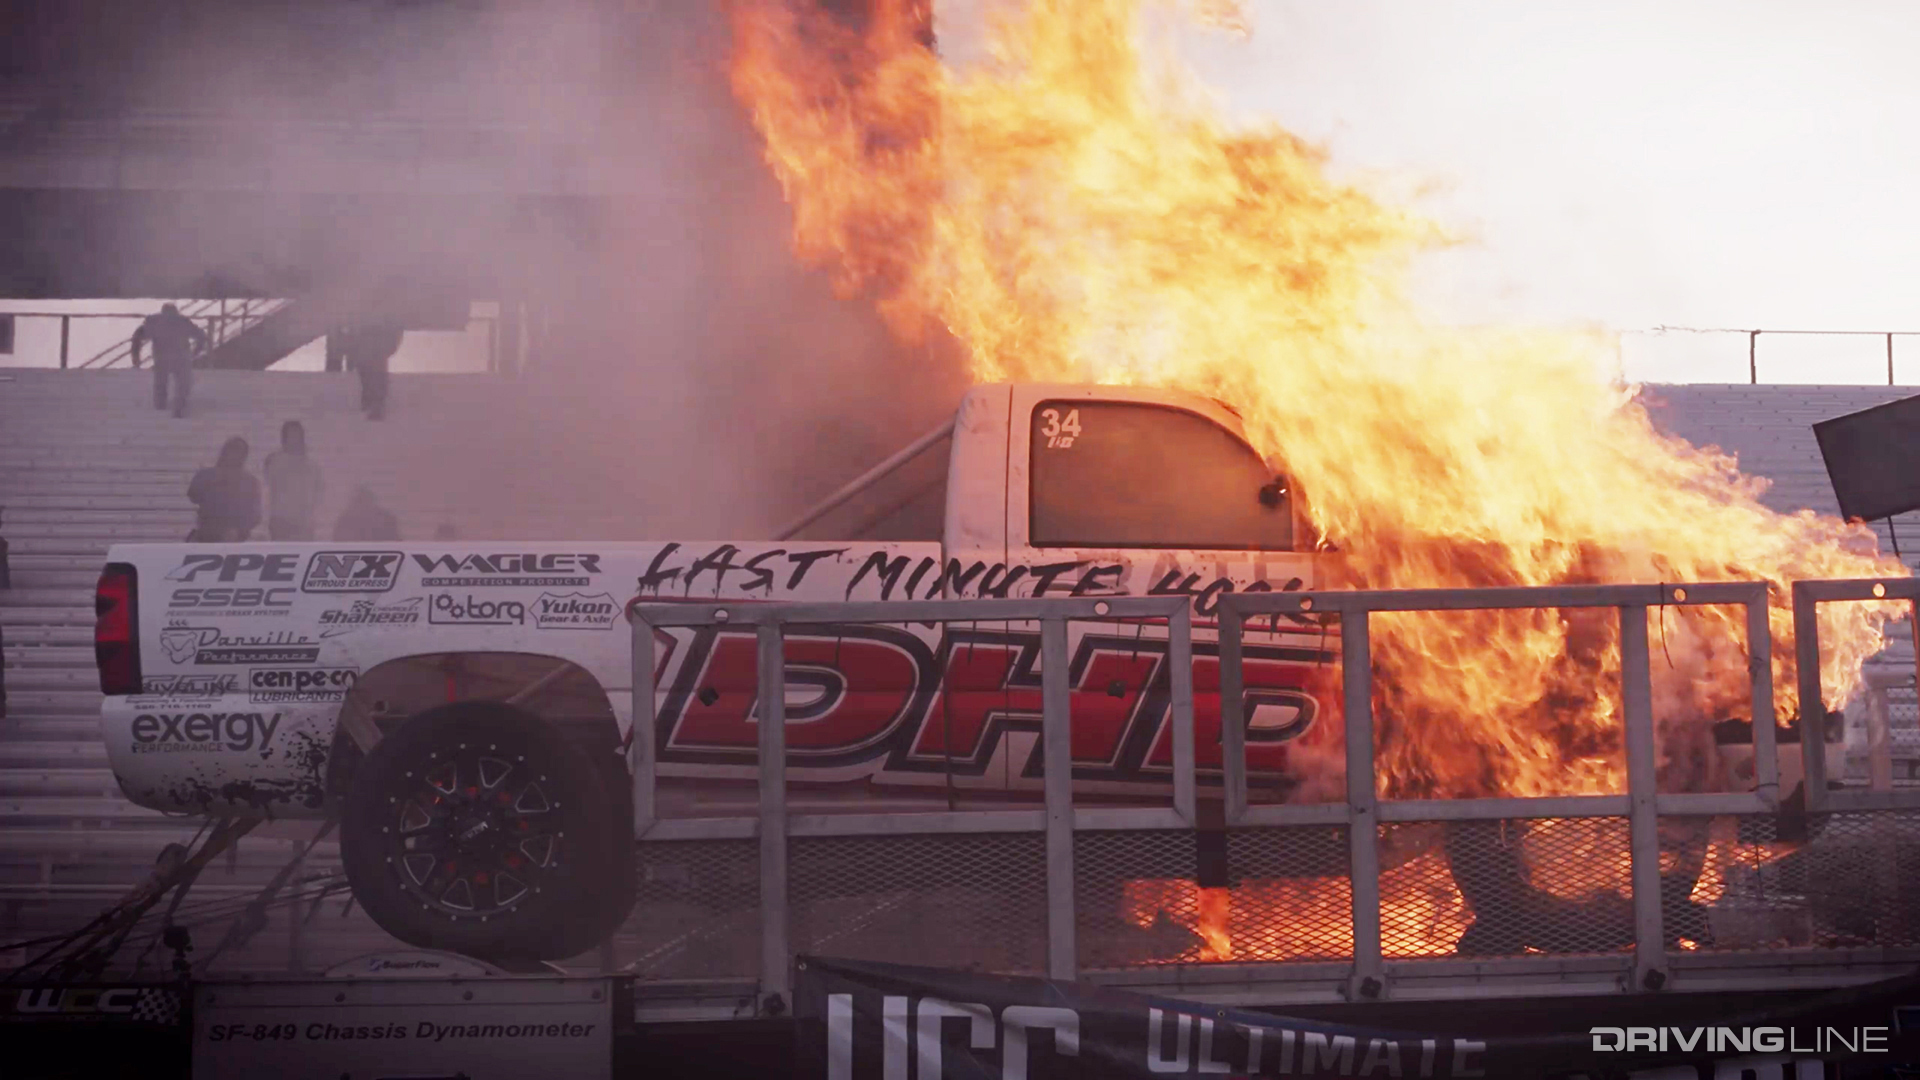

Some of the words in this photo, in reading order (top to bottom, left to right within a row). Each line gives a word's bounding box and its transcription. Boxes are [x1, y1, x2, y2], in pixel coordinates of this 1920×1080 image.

[1041, 408, 1081, 438] 34
[168, 554, 299, 582] PPE
[310, 555, 398, 578] NX
[411, 554, 601, 573] WAGLER
[637, 543, 851, 595] LAST
[845, 551, 1124, 600] MINUTE
[305, 579, 346, 588] NITROUS
[348, 579, 389, 588] EXPRESS
[423, 577, 513, 586] COMPETITION
[519, 577, 589, 586] PRODUCTS
[169, 588, 296, 607] SSBC
[541, 599, 612, 614] Yukon
[318, 607, 419, 624] Shaheen
[540, 615, 568, 623] Gear
[570, 615, 579, 623] &
[582, 615, 611, 624] Axle
[199, 627, 319, 647] Danville
[202, 650, 316, 664] Performance
[253, 691, 343, 701] LUBRICANTS
[132, 713, 282, 751] exergy
[132, 742, 224, 753] PERFORMANCE
[209, 1021, 297, 1042] SF-849
[305, 1020, 407, 1041] Chassis
[416, 1020, 595, 1042] Dynamometer
[1148, 1007, 1486, 1077] ULTIMATE
